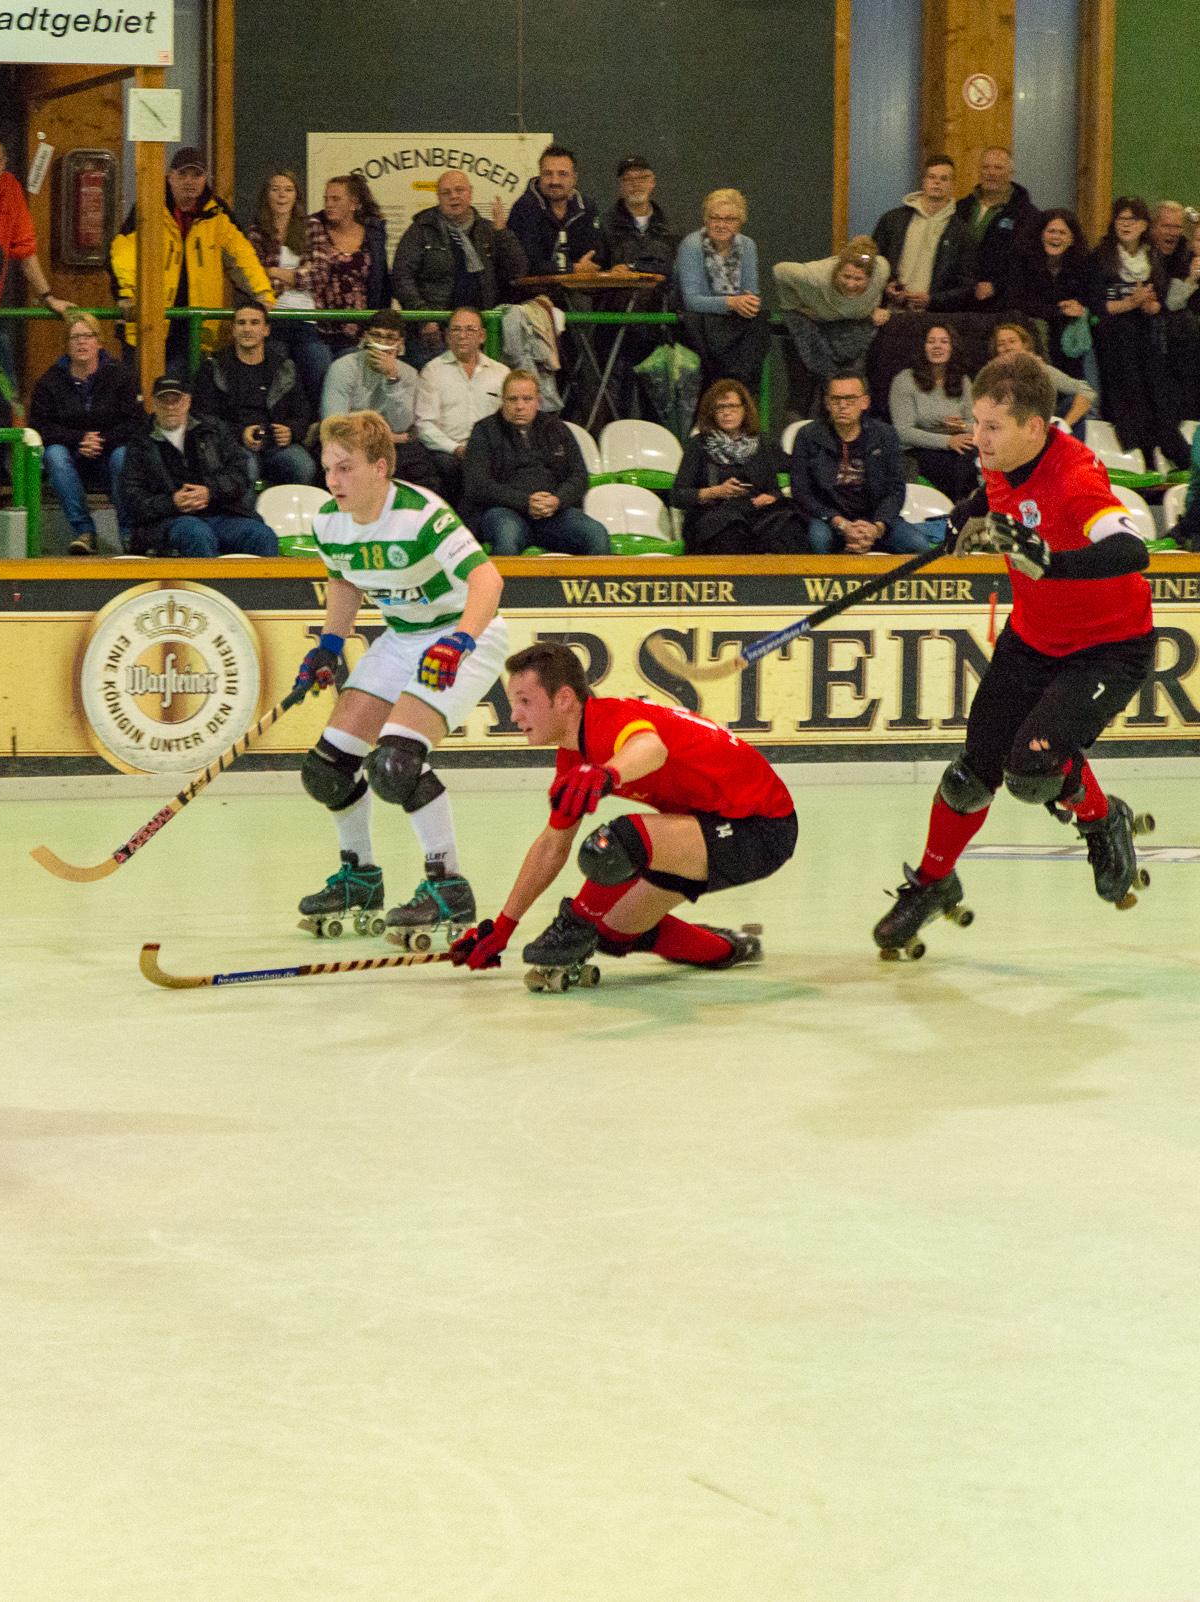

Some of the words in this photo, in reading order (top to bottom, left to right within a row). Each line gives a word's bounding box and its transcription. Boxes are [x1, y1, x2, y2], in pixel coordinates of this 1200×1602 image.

[359, 544, 384, 570] 18
[561, 580, 735, 603] WARSTEINER
[103, 635, 132, 673] EINE
[211, 635, 240, 696] BIEREN
[1092, 682, 1105, 700] 7
[103, 681, 145, 744] KÖNIGIN
[206, 703, 233, 735] DEN
[150, 732, 205, 752] UNTER
